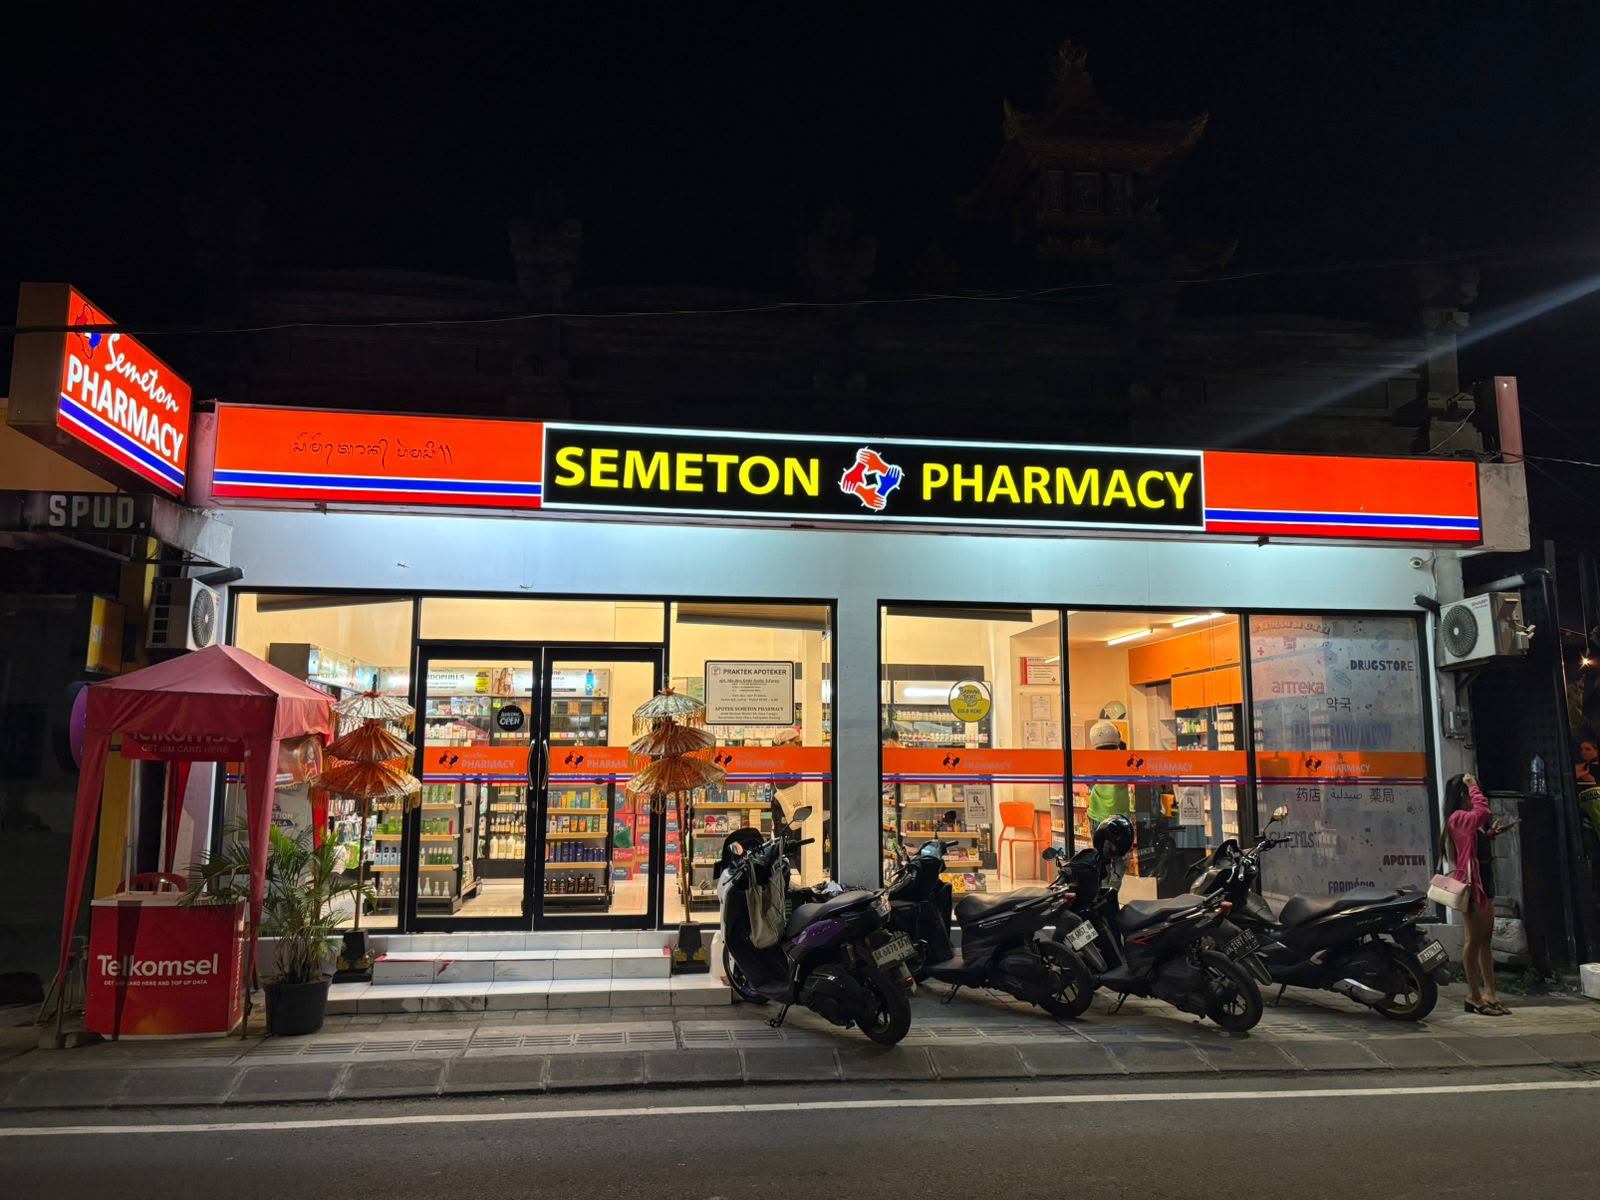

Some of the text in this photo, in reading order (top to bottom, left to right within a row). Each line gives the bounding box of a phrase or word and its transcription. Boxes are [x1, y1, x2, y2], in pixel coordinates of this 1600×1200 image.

[105, 333, 179, 413] Semeton
[66, 354, 184, 463] PHARMACY
[555, 447, 1193, 508] SEMETON PHARMACY
[1350, 659, 1414, 672] DRUGSTORE
[1326, 697, 1352, 712] 약국
[499, 716, 520, 726] OPEN
[177, 745, 202, 753] CARD
[461, 760, 516, 769] PHARMACY
[586, 760, 627, 769] PHARMA
[1146, 762, 1193, 771] PHARMACY
[1325, 764, 1371, 773] PHARMACY
[1296, 788, 1321, 801] 药店
[1369, 788, 1395, 802] 薬局
[1382, 854, 1426, 867] APOTEK
[97, 953, 219, 977] Telkomsel
